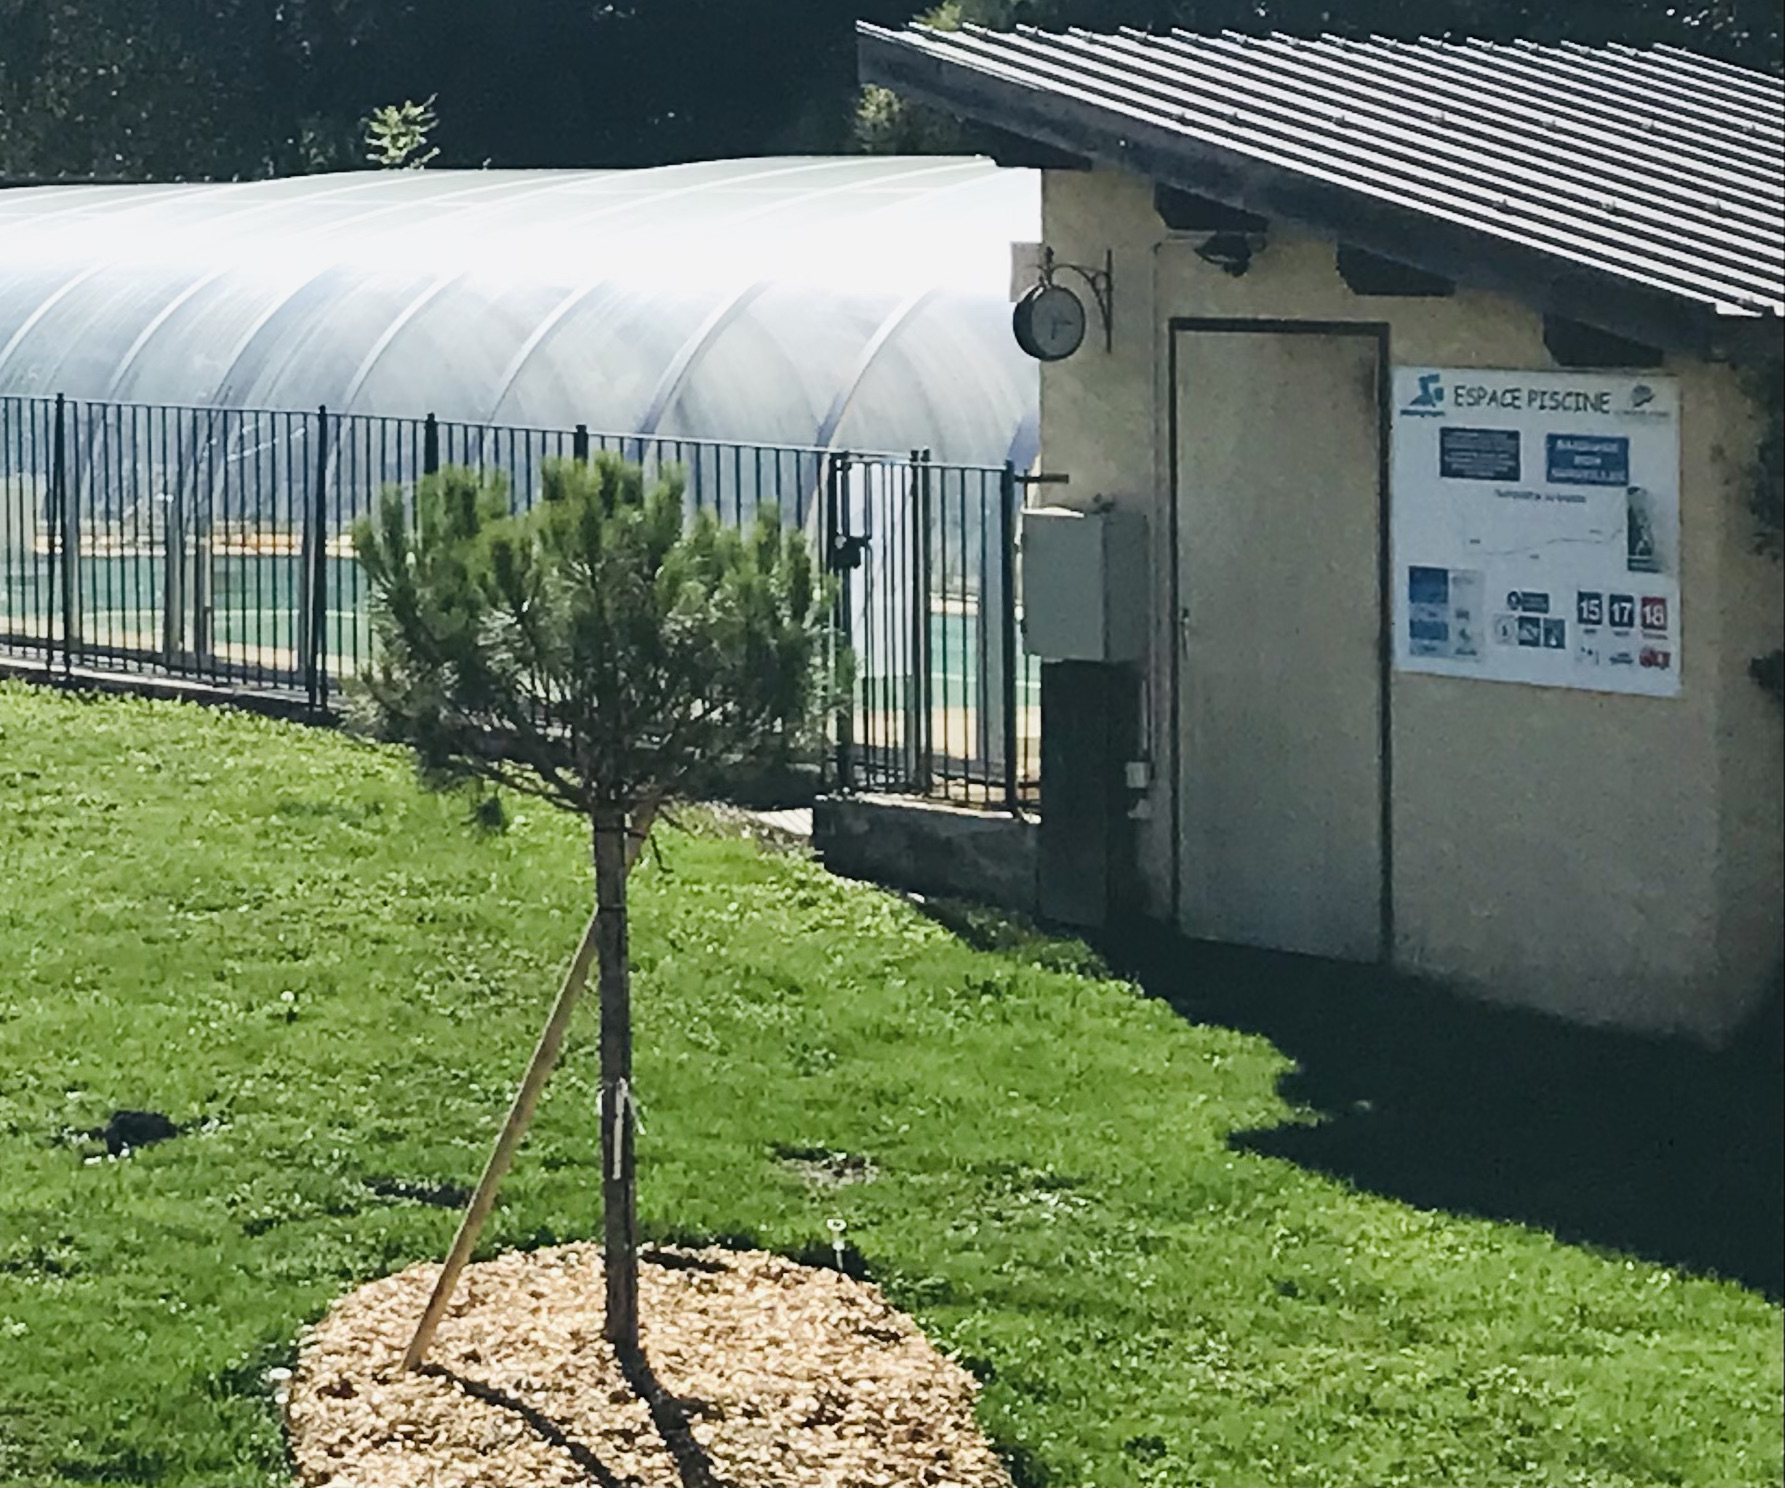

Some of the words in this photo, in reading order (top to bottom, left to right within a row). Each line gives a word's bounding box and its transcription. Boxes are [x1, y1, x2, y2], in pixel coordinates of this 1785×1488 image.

[1454, 385, 1522, 410] ESPACE
[1527, 389, 1611, 414] PISCINE
[1580, 598, 1600, 620] 15
[1612, 602, 1632, 623] 17
[1643, 605, 1664, 626] 18
